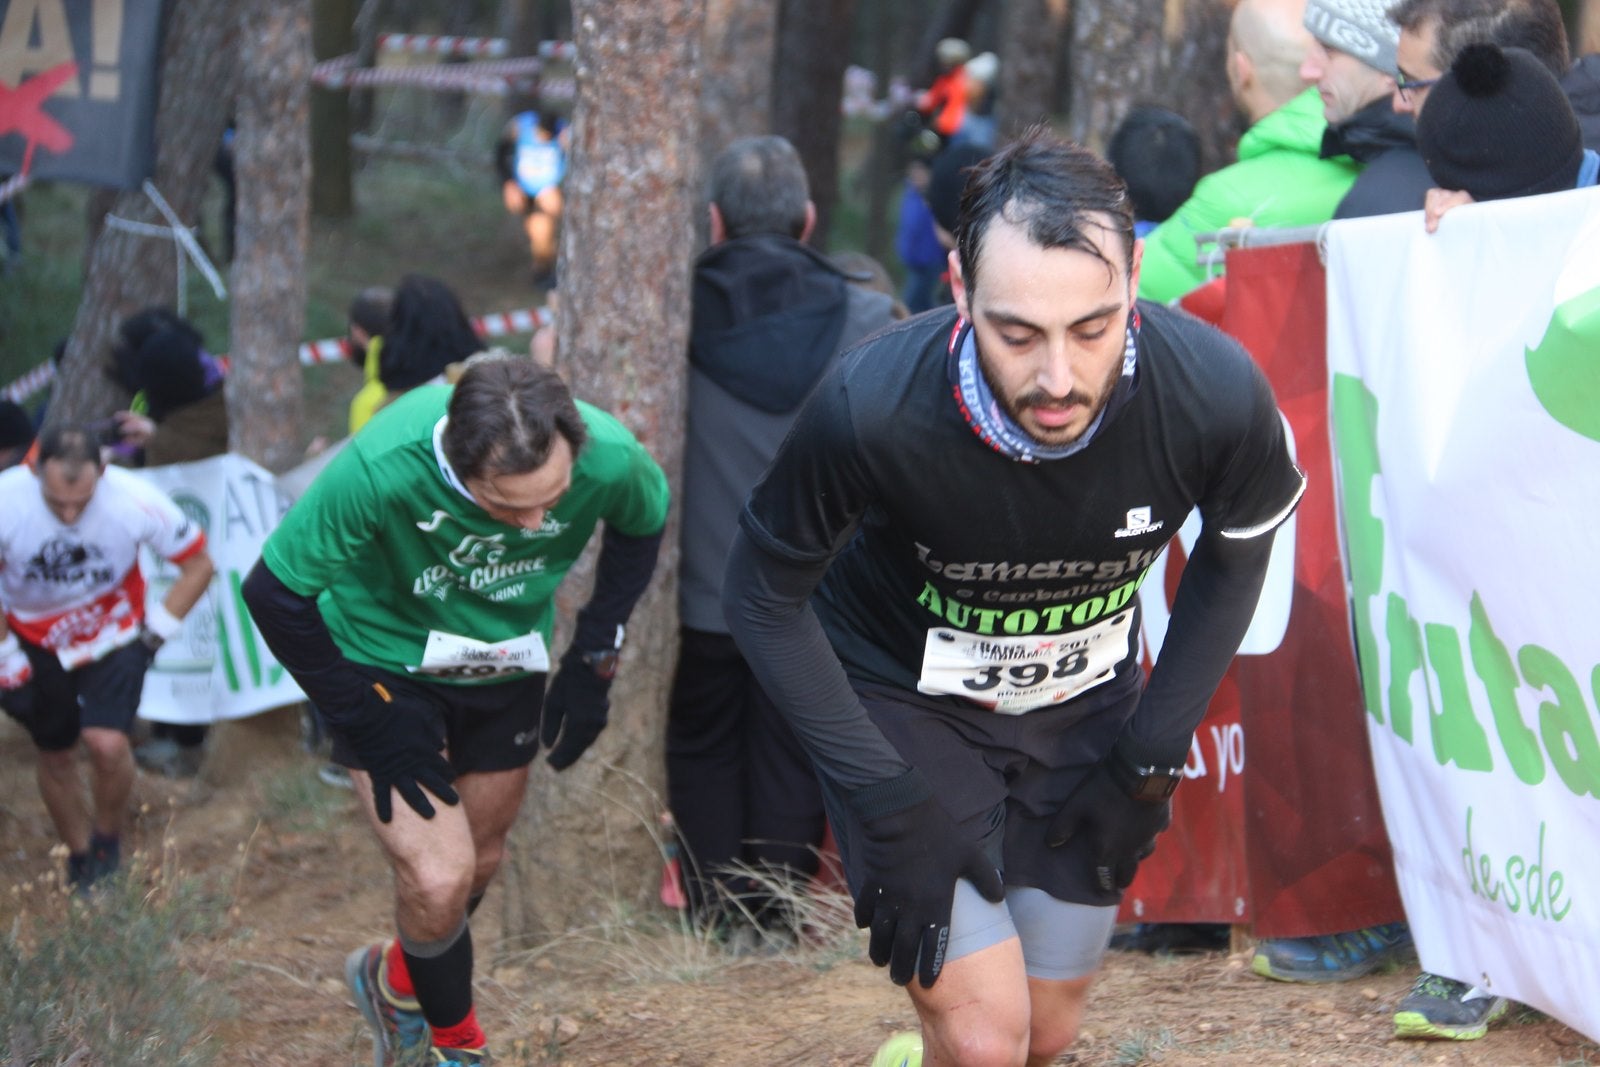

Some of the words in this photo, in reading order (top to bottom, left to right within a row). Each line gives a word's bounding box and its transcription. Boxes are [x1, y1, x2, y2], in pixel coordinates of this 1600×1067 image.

[962, 648, 1091, 692] 398
[1210, 722, 1245, 793] yo
[1461, 806, 1573, 923] desde
